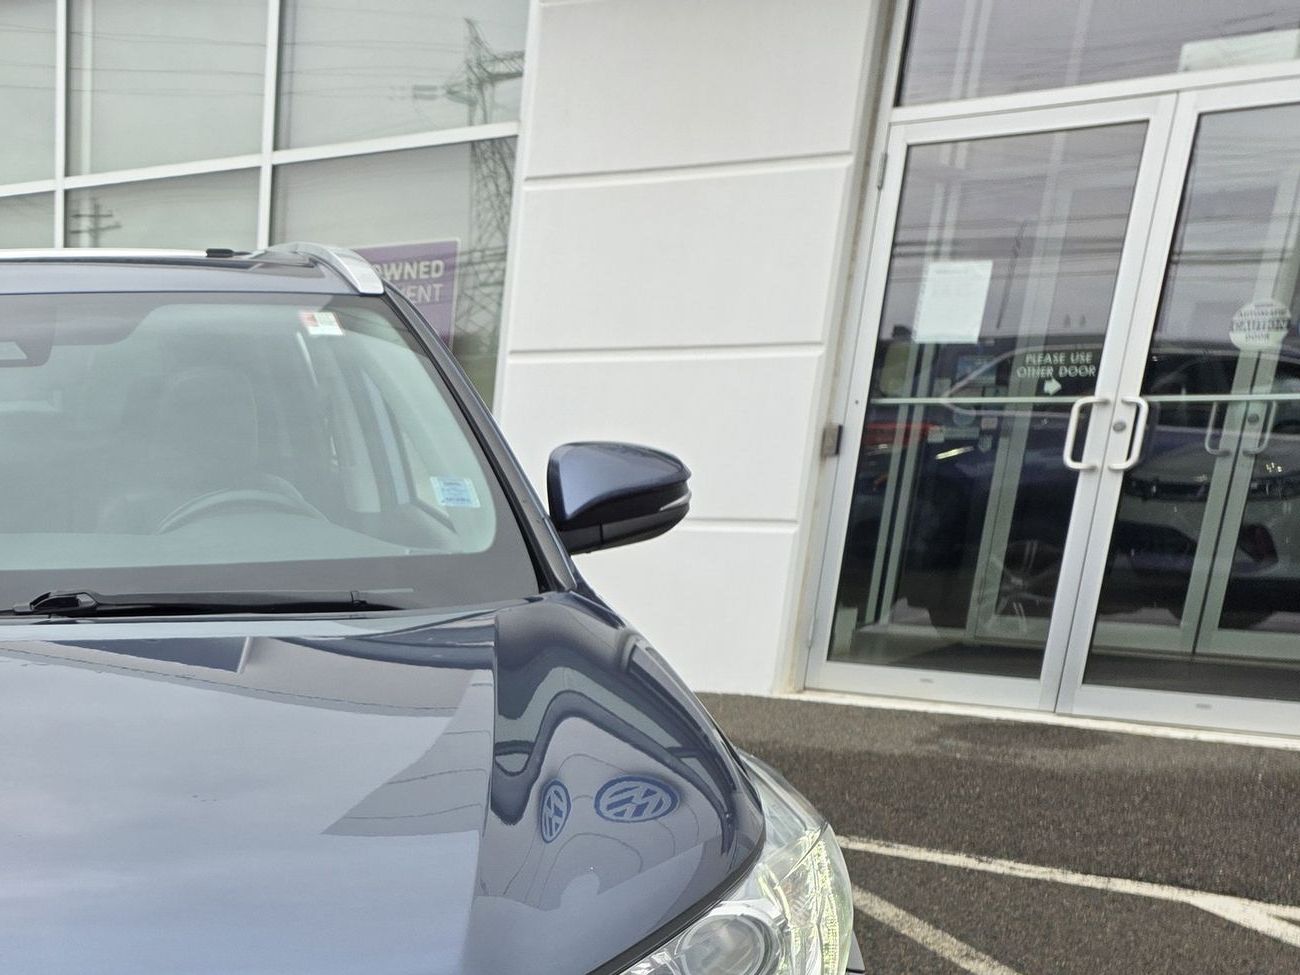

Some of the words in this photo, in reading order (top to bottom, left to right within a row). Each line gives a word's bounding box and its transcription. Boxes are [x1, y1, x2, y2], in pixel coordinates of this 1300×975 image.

[1025, 352, 1066, 365] PLEASE
[1070, 351, 1093, 364] USE
[1016, 365, 1054, 378] OTHER
[1058, 365, 1097, 377] DOOR
